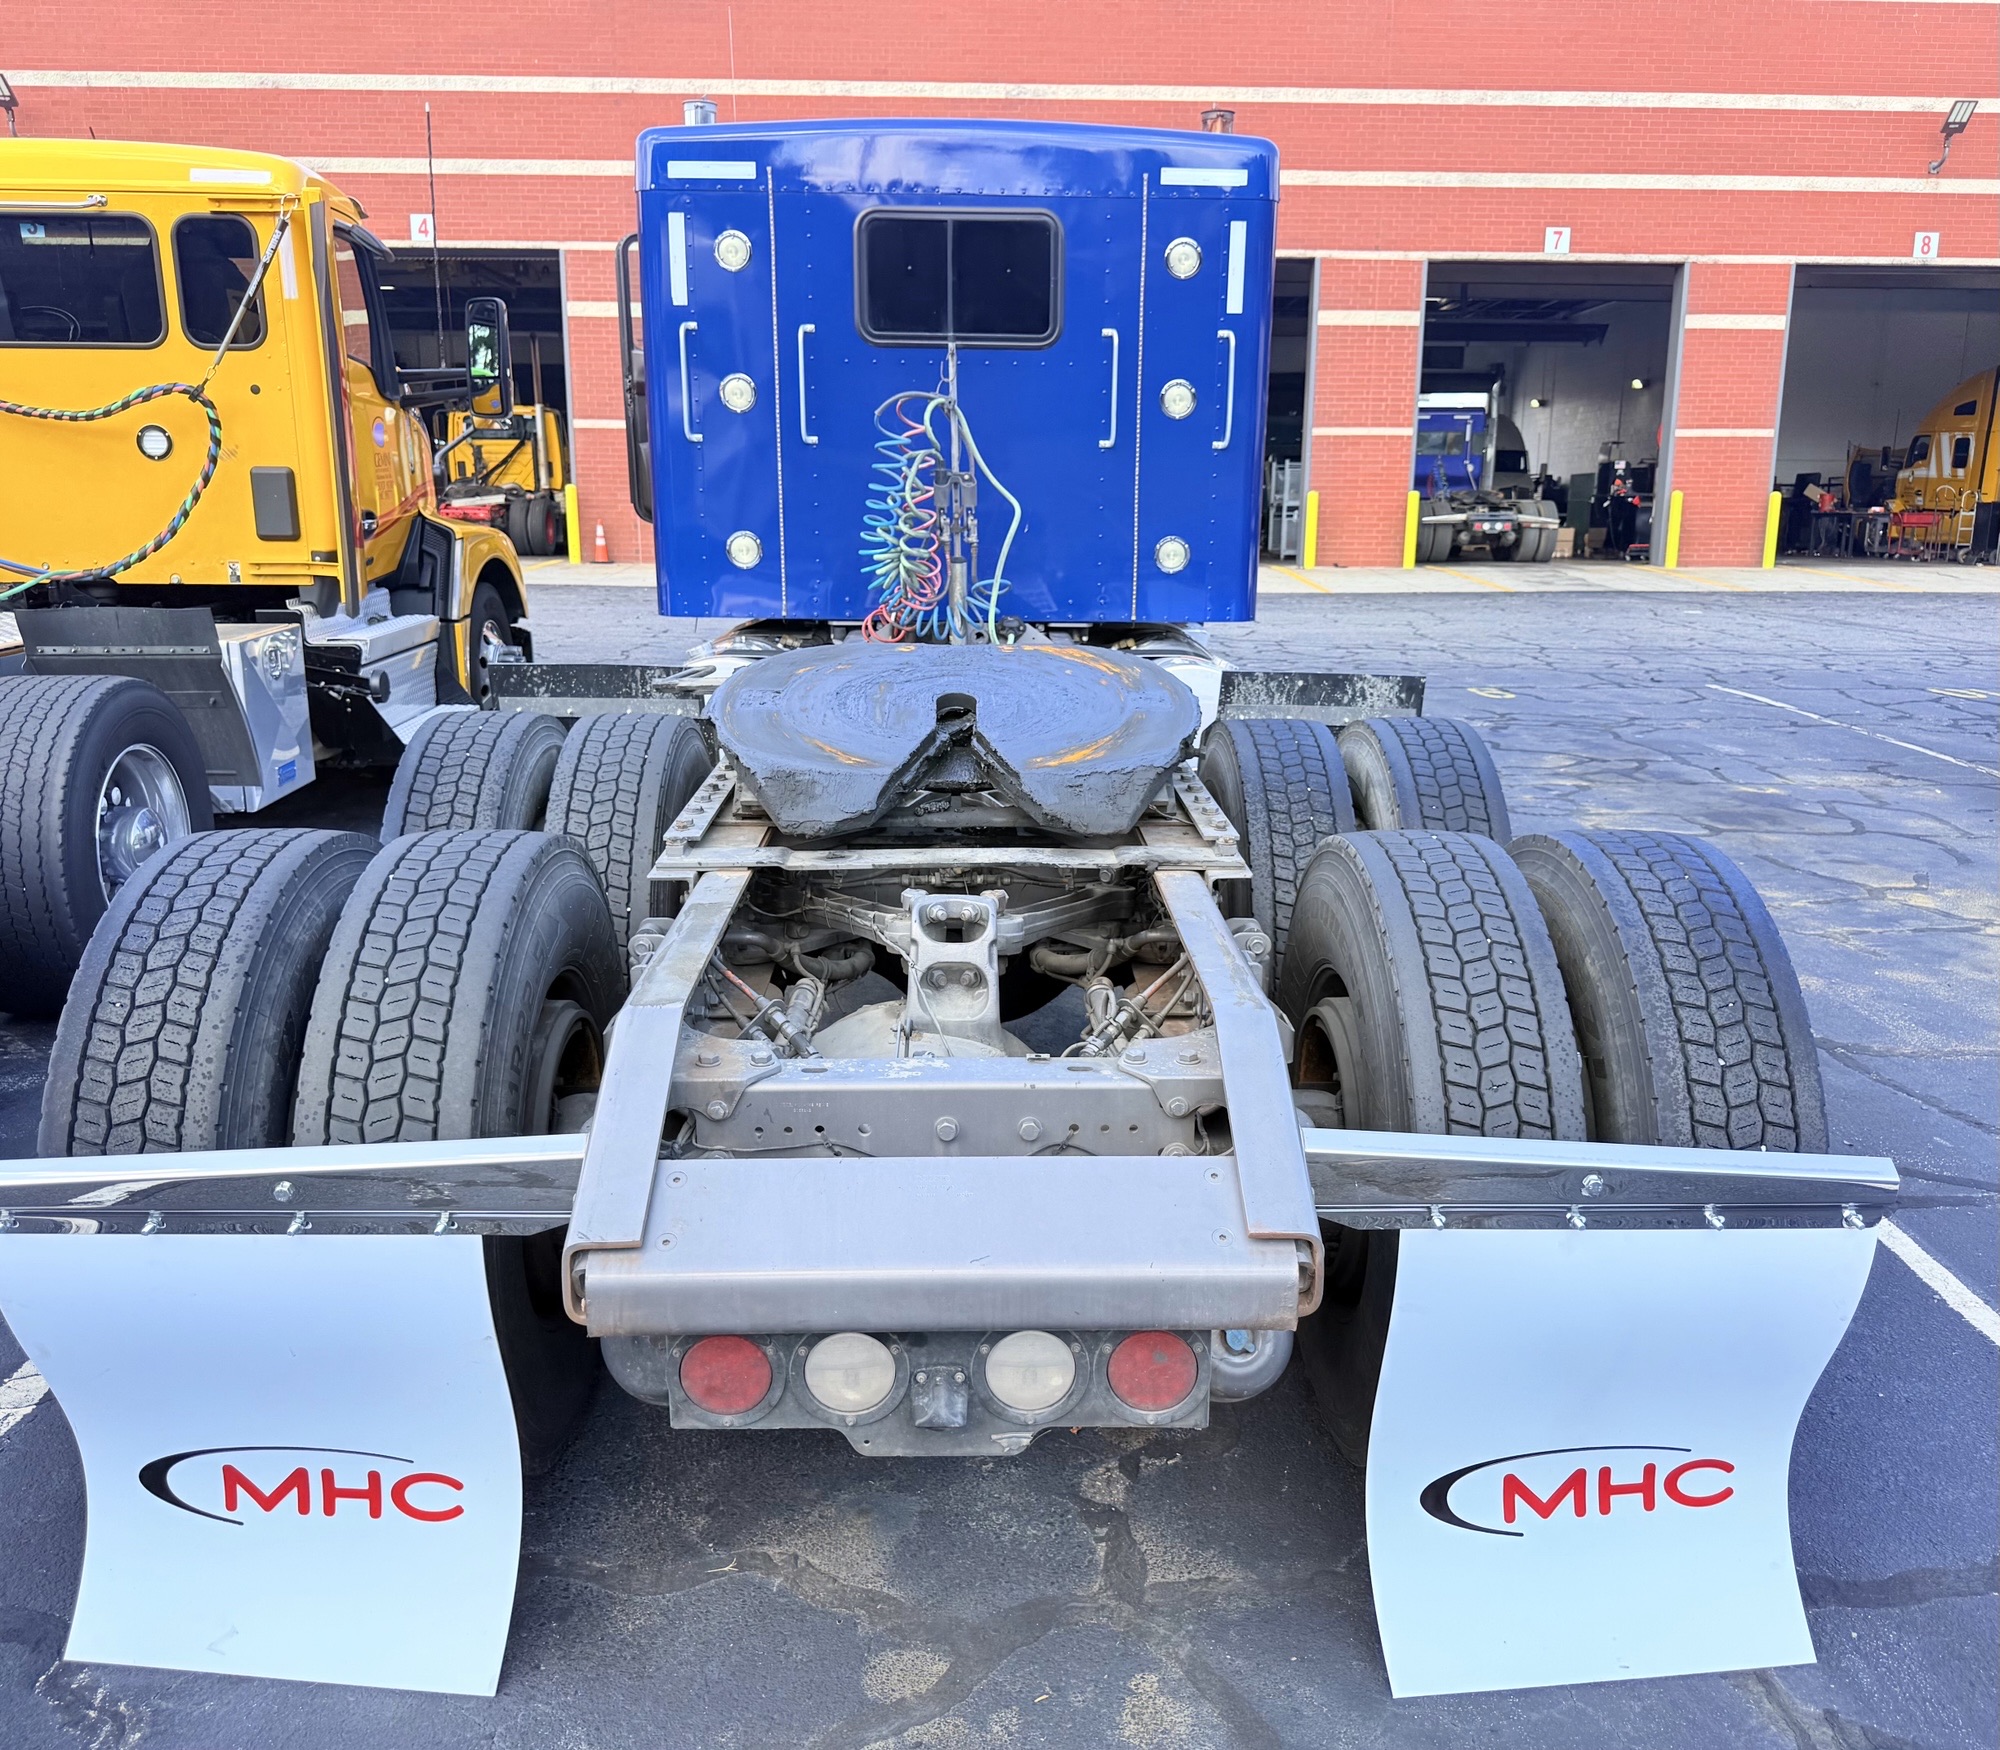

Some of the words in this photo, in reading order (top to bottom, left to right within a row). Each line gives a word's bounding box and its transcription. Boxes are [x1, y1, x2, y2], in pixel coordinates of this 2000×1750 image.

[418, 218, 430, 238] 4
[1553, 231, 1563, 250] 7
[1921, 235, 1931, 255] 8
[223, 1466, 464, 1522] MHC
[1504, 1460, 1734, 1523] MHC
